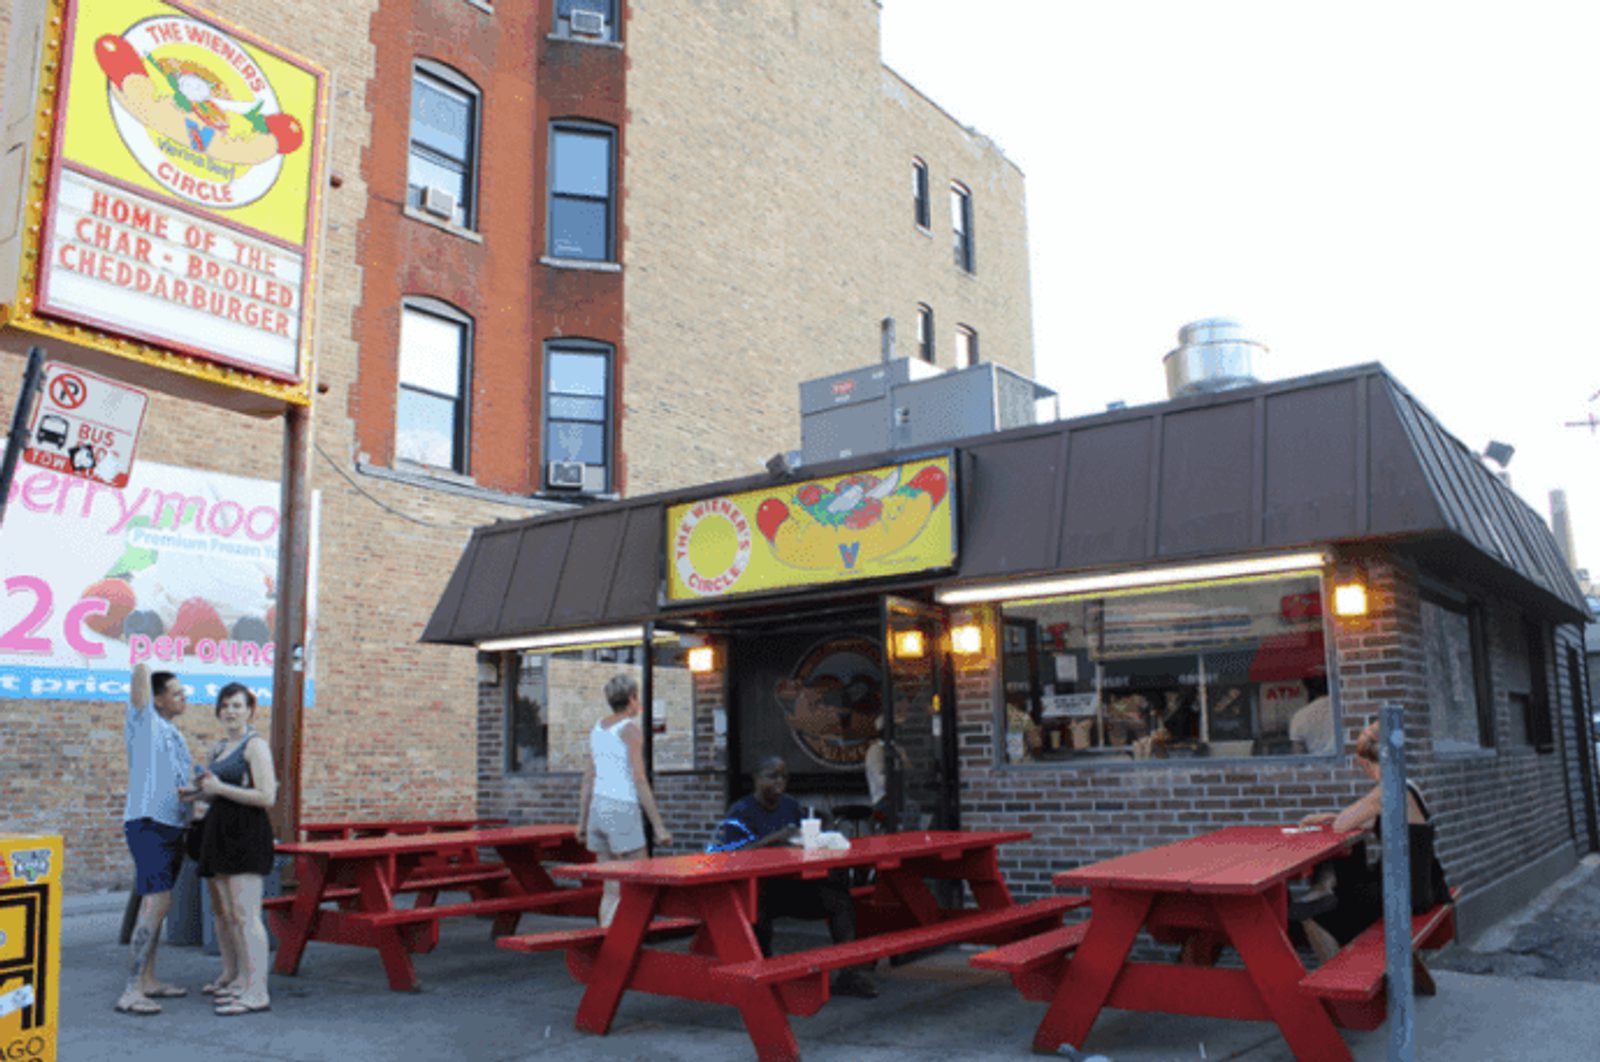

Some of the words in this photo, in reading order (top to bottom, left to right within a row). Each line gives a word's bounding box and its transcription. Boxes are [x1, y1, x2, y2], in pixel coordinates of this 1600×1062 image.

[146, 21, 183, 44] THE
[185, 24, 266, 93] WIENERS
[157, 161, 234, 203] CIRCLE
[91, 191, 169, 240] HOME
[184, 224, 216, 253] OF
[234, 240, 277, 278] THE
[75, 217, 152, 263] CHAR
[187, 254, 294, 309] BROILED
[58, 243, 290, 338] CHEDDARBURGER
[78, 422, 115, 449] BUS
[134, 527, 207, 551] Premium
[677, 522, 692, 561] THE
[688, 567, 740, 593] CIRCLE
[130, 633, 190, 665] per
[1265, 685, 1301, 700] ATM
